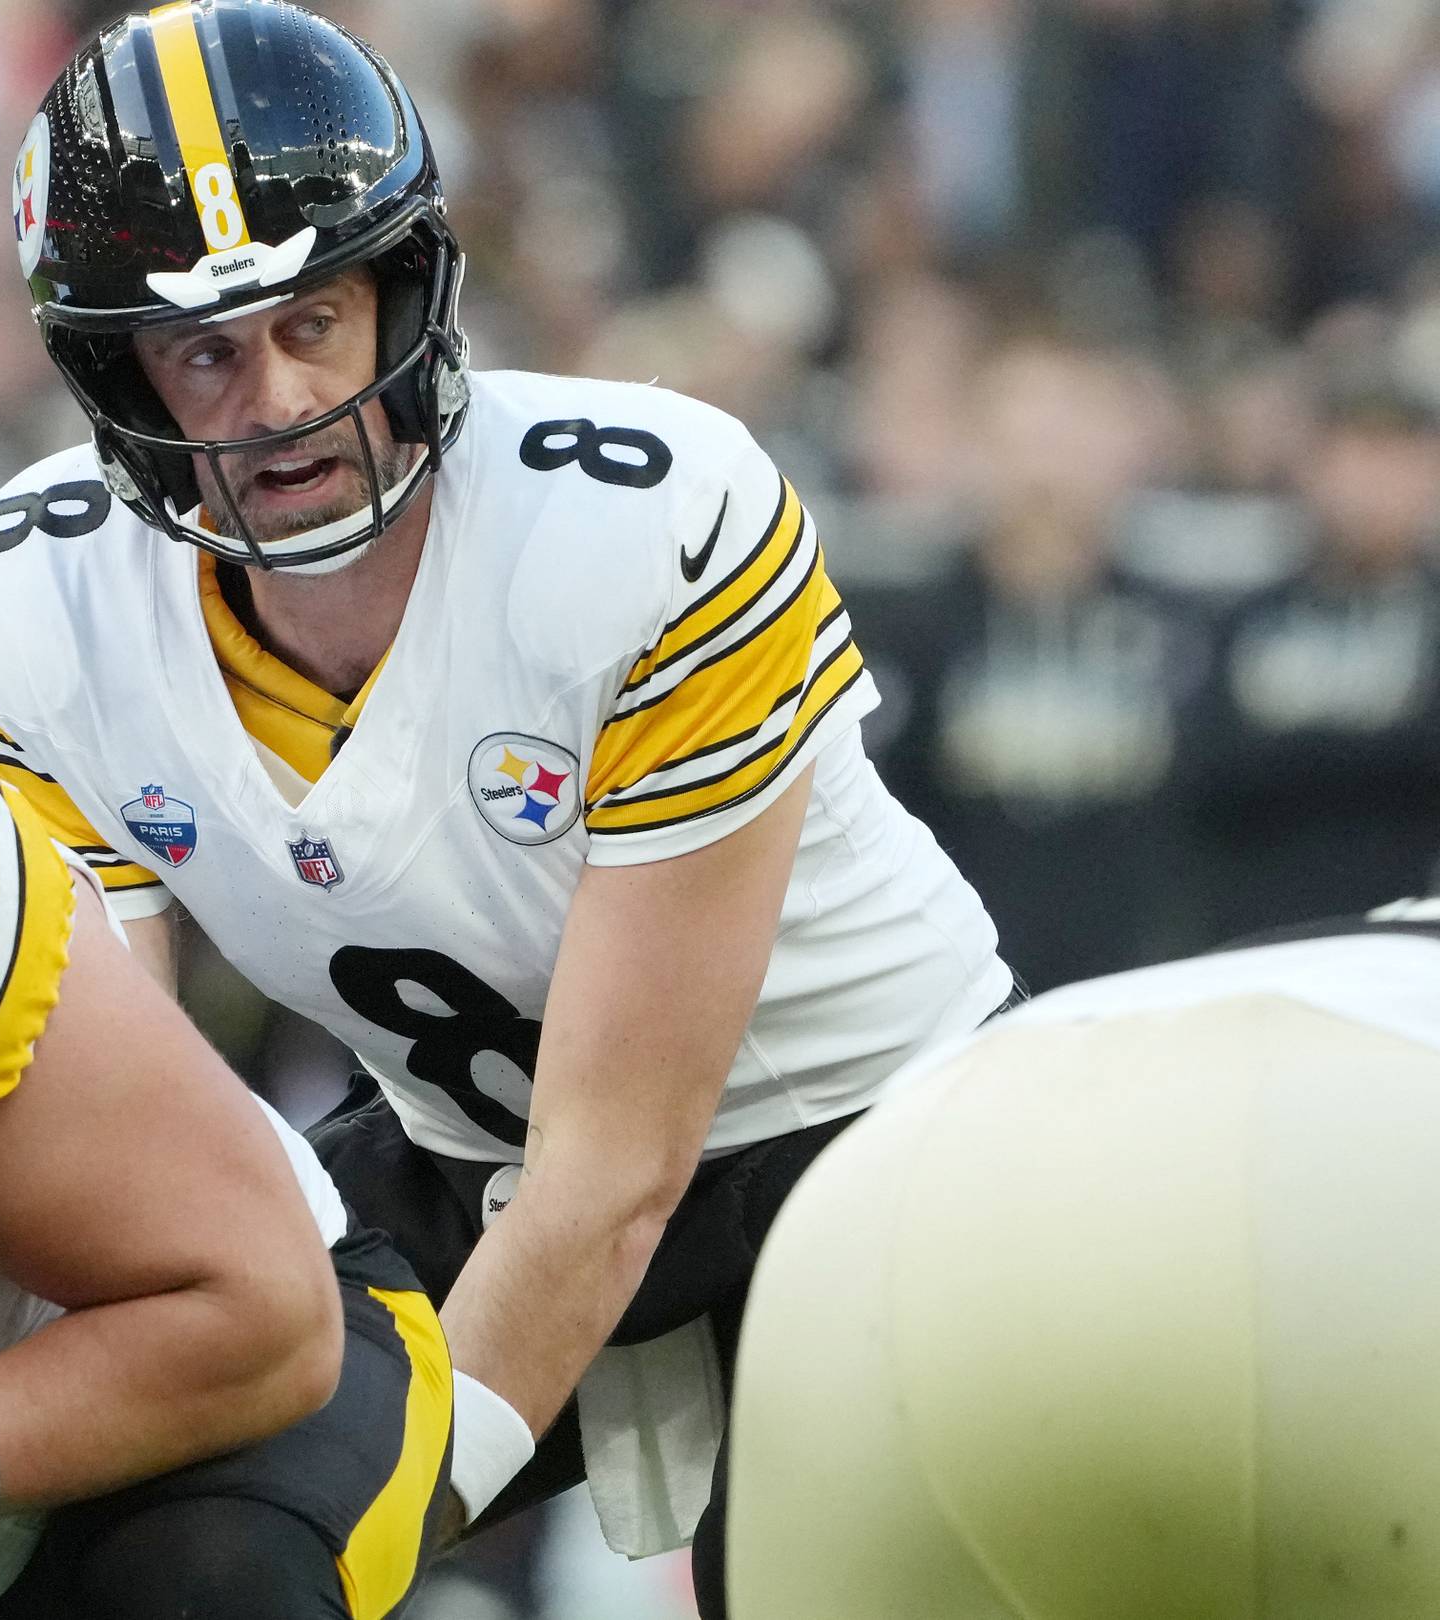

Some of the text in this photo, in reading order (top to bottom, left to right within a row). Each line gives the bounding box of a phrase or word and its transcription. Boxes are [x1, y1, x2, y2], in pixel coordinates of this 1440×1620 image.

[194, 163, 243, 249] 8
[211, 257, 255, 277] Steelers
[520, 418, 673, 489] 8
[481, 785, 524, 801] Steelers
[140, 825, 183, 837] PARIS
[299, 860, 336, 883] NFL
[329, 945, 543, 1149] 8
